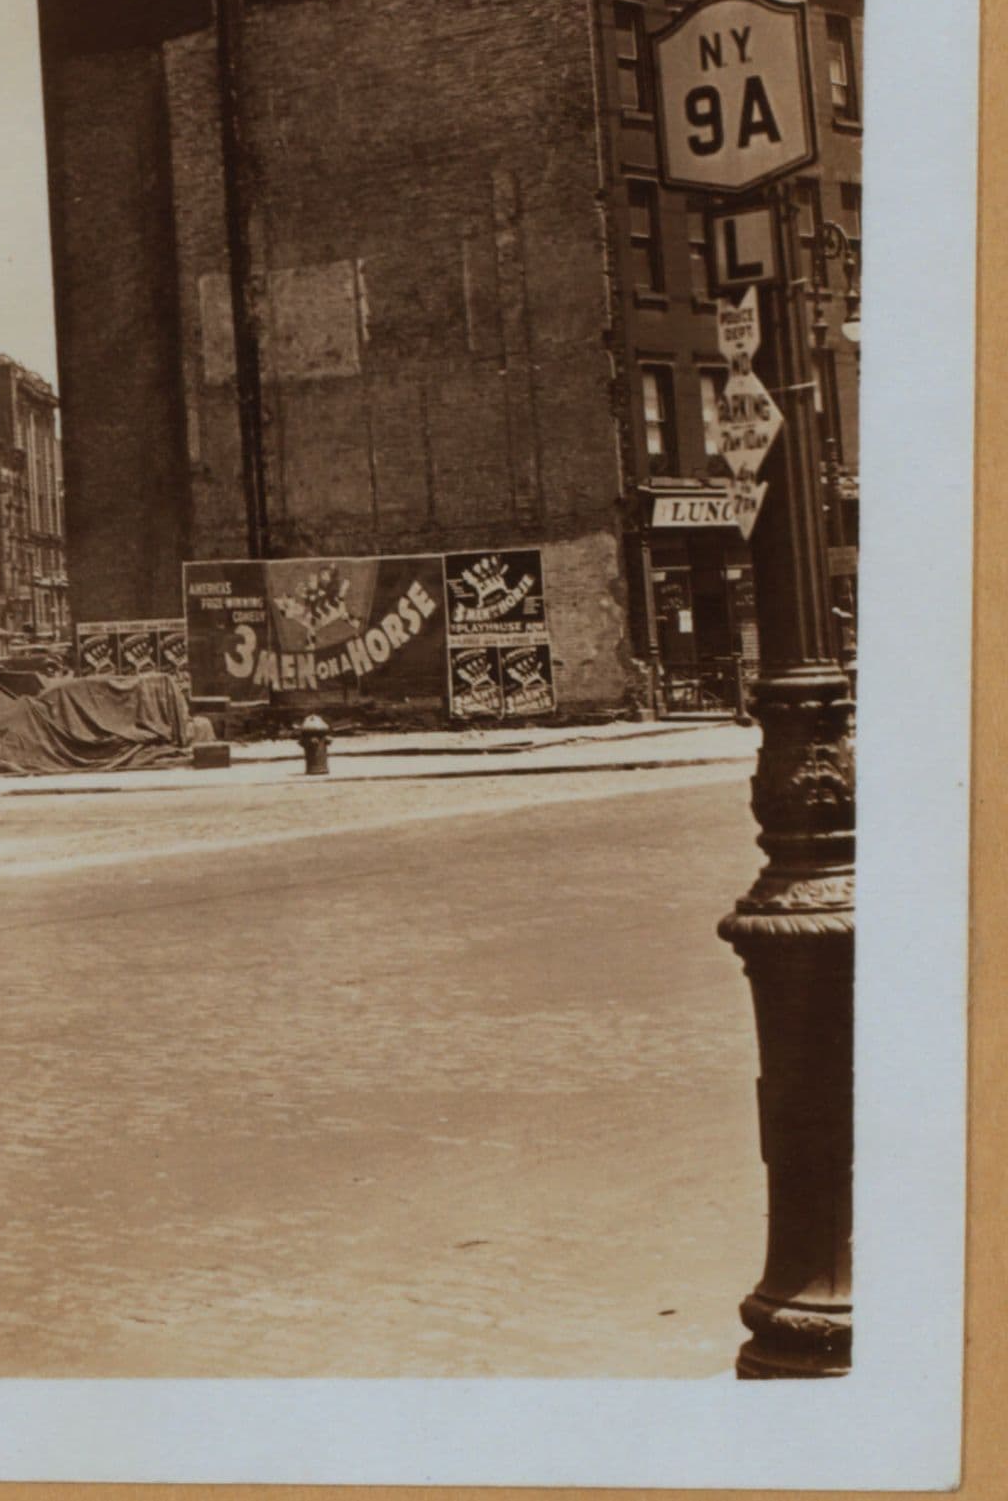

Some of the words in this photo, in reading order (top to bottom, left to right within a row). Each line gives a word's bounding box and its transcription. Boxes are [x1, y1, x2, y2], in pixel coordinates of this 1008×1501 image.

[684, 75, 781, 157] 9A
[723, 219, 763, 280] L
[720, 308, 754, 324] POLICE
[731, 352, 750, 376] NO
[718, 394, 770, 422] PARKING
[671, 501, 734, 523] LUNC
[224, 624, 256, 678] 3
[253, 650, 317, 691] MEN
[316, 657, 339, 680] ON
[341, 653, 353, 672] A
[347, 580, 437, 677] HORSE
